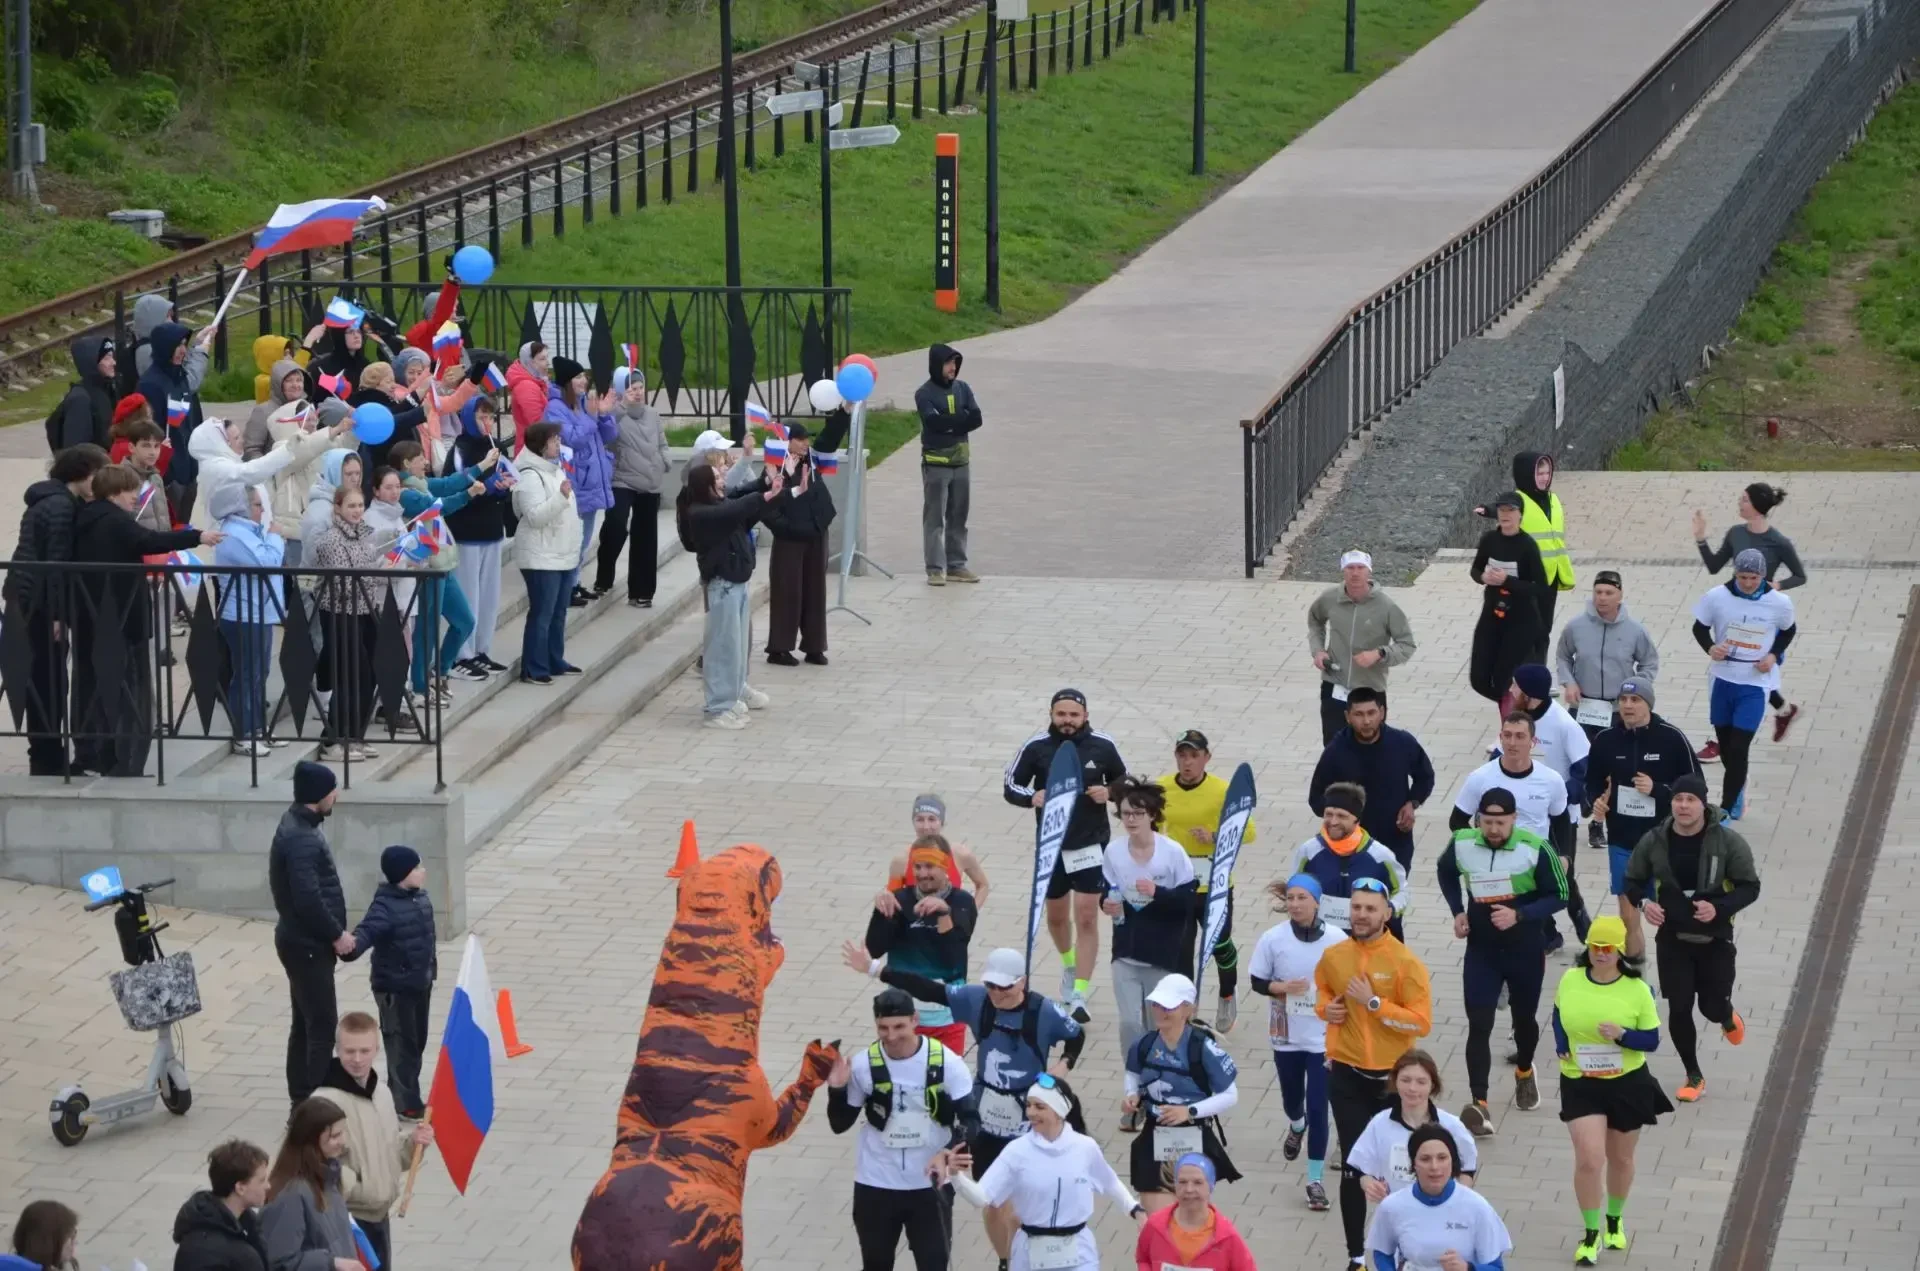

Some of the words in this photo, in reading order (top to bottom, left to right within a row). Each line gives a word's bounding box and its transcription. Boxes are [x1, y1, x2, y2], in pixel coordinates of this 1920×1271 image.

[941, 179, 950, 268] ПОЛИЦИЯ
[1043, 806, 1065, 837] 6:10
[1216, 826, 1238, 857] 6:10
